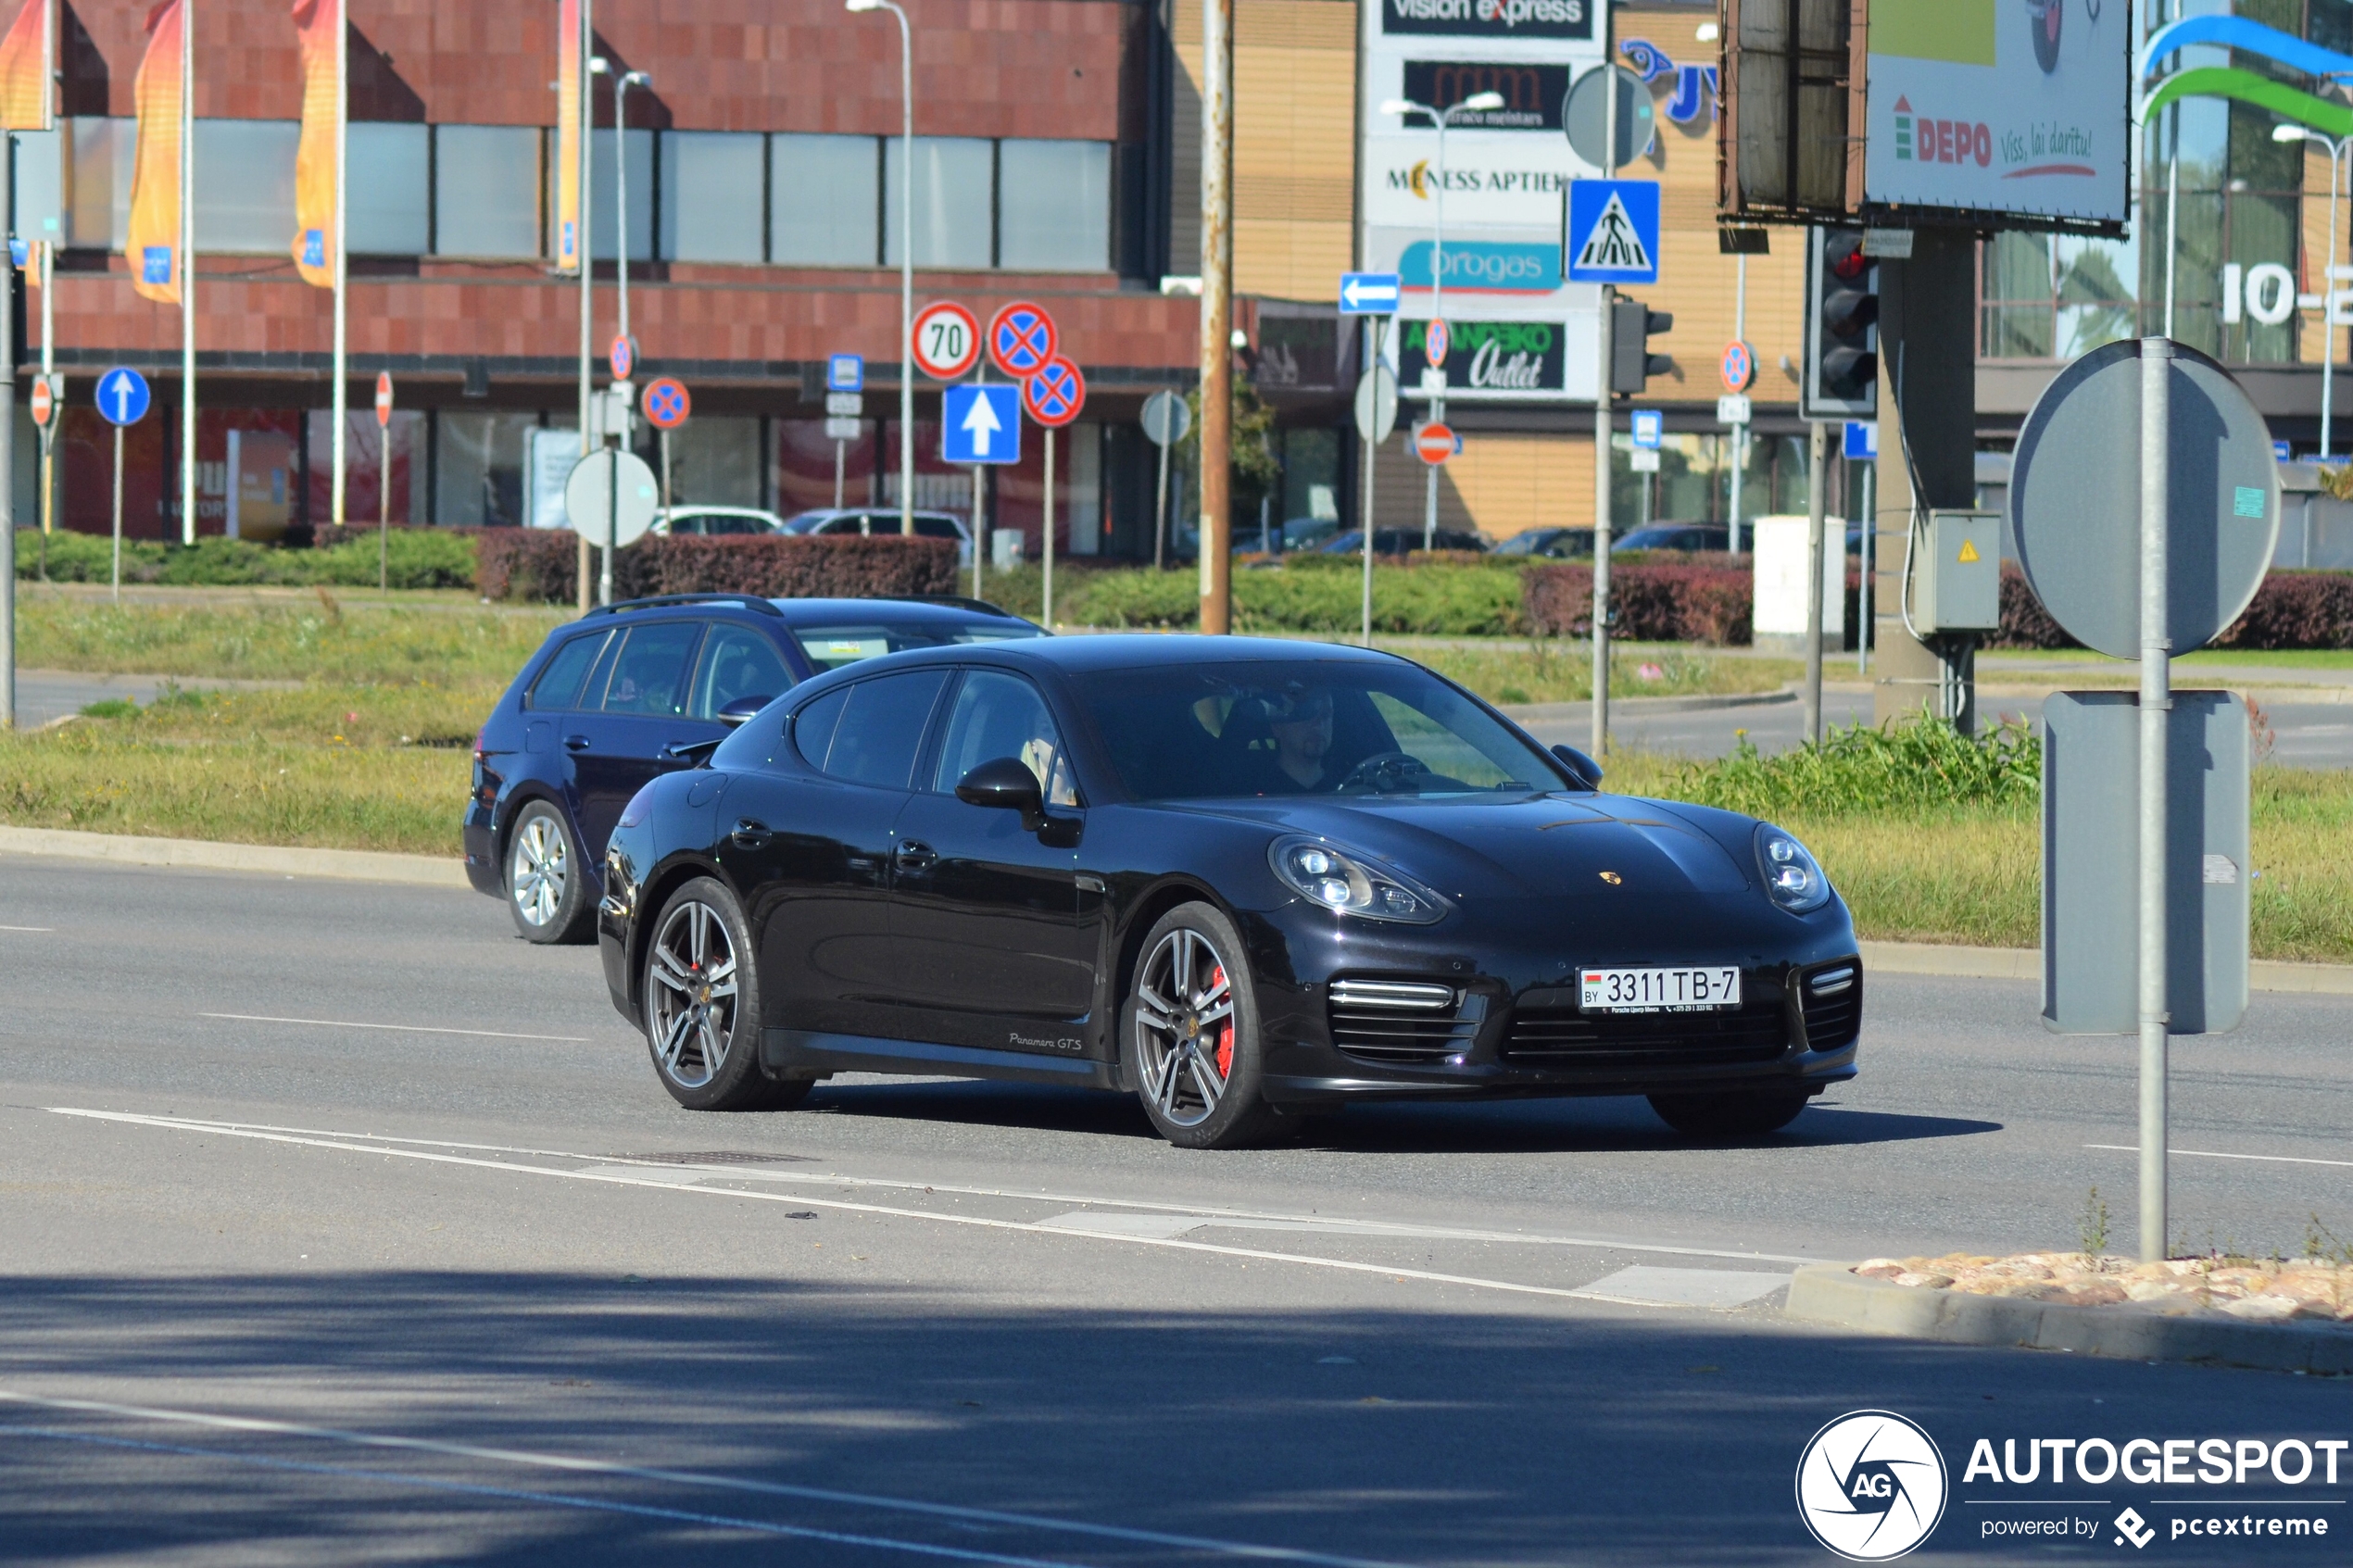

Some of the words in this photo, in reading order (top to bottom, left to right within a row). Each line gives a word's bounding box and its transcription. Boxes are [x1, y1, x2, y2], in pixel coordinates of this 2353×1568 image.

[1395, 0, 1471, 19] vision
[1476, 0, 1583, 28] express
[1918, 118, 1992, 168] DEPO
[2031, 121, 2045, 156] lai
[1429, 249, 1542, 282] Drogas
[931, 324, 963, 358] 70
[1469, 337, 1543, 389] Outlet
[1585, 991, 1598, 1003] BY
[1009, 1033, 1055, 1047] Panamera
[1057, 1038, 1082, 1050] GTS
